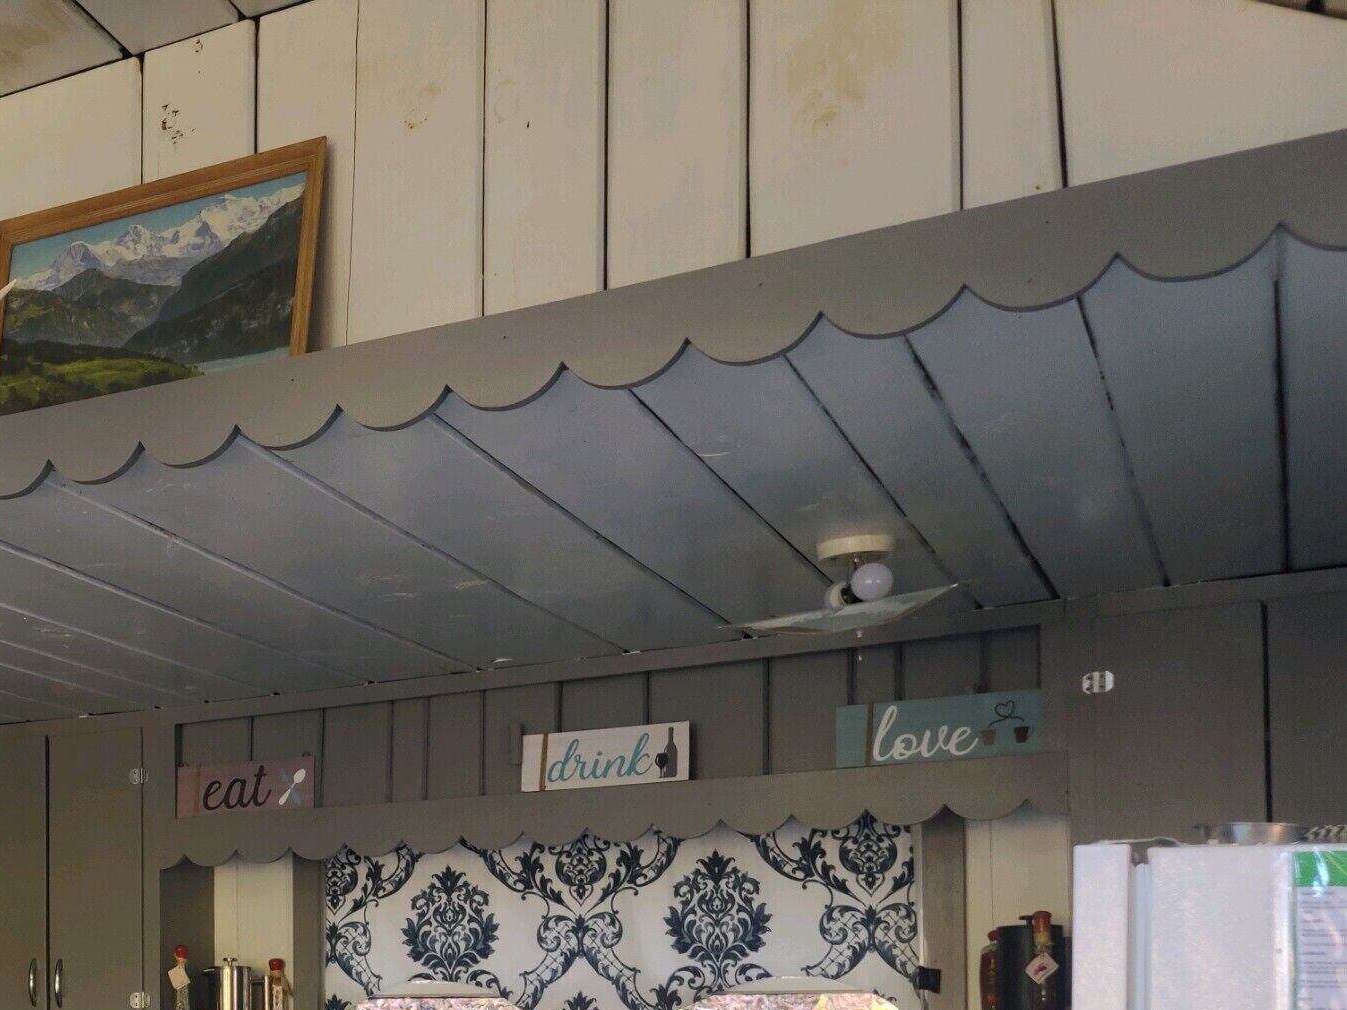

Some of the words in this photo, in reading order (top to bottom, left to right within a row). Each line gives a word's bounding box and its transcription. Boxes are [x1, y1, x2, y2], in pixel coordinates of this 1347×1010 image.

[547, 732, 653, 783] drink
[873, 705, 978, 761] love
[203, 765, 272, 811] eat
